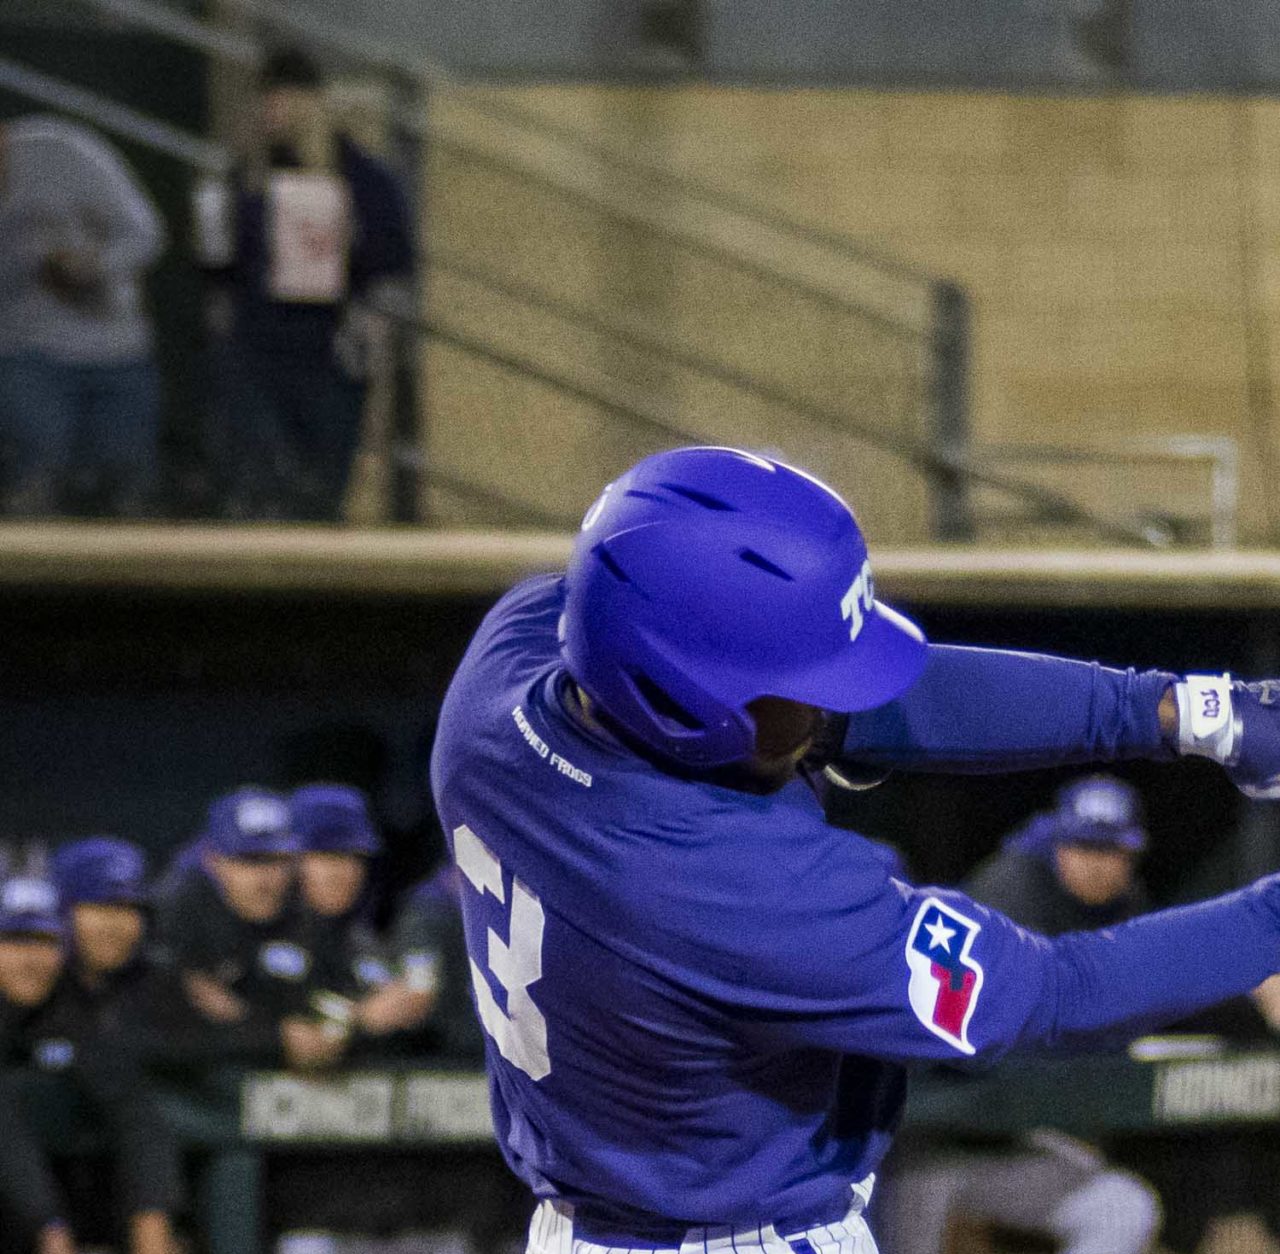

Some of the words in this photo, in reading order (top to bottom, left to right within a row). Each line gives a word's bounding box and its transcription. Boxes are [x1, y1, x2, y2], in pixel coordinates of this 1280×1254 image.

[1200, 689, 1221, 718] TCU
[511, 705, 550, 758] HORNED
[549, 752, 593, 788] FROGS
[453, 824, 551, 1082] 3
